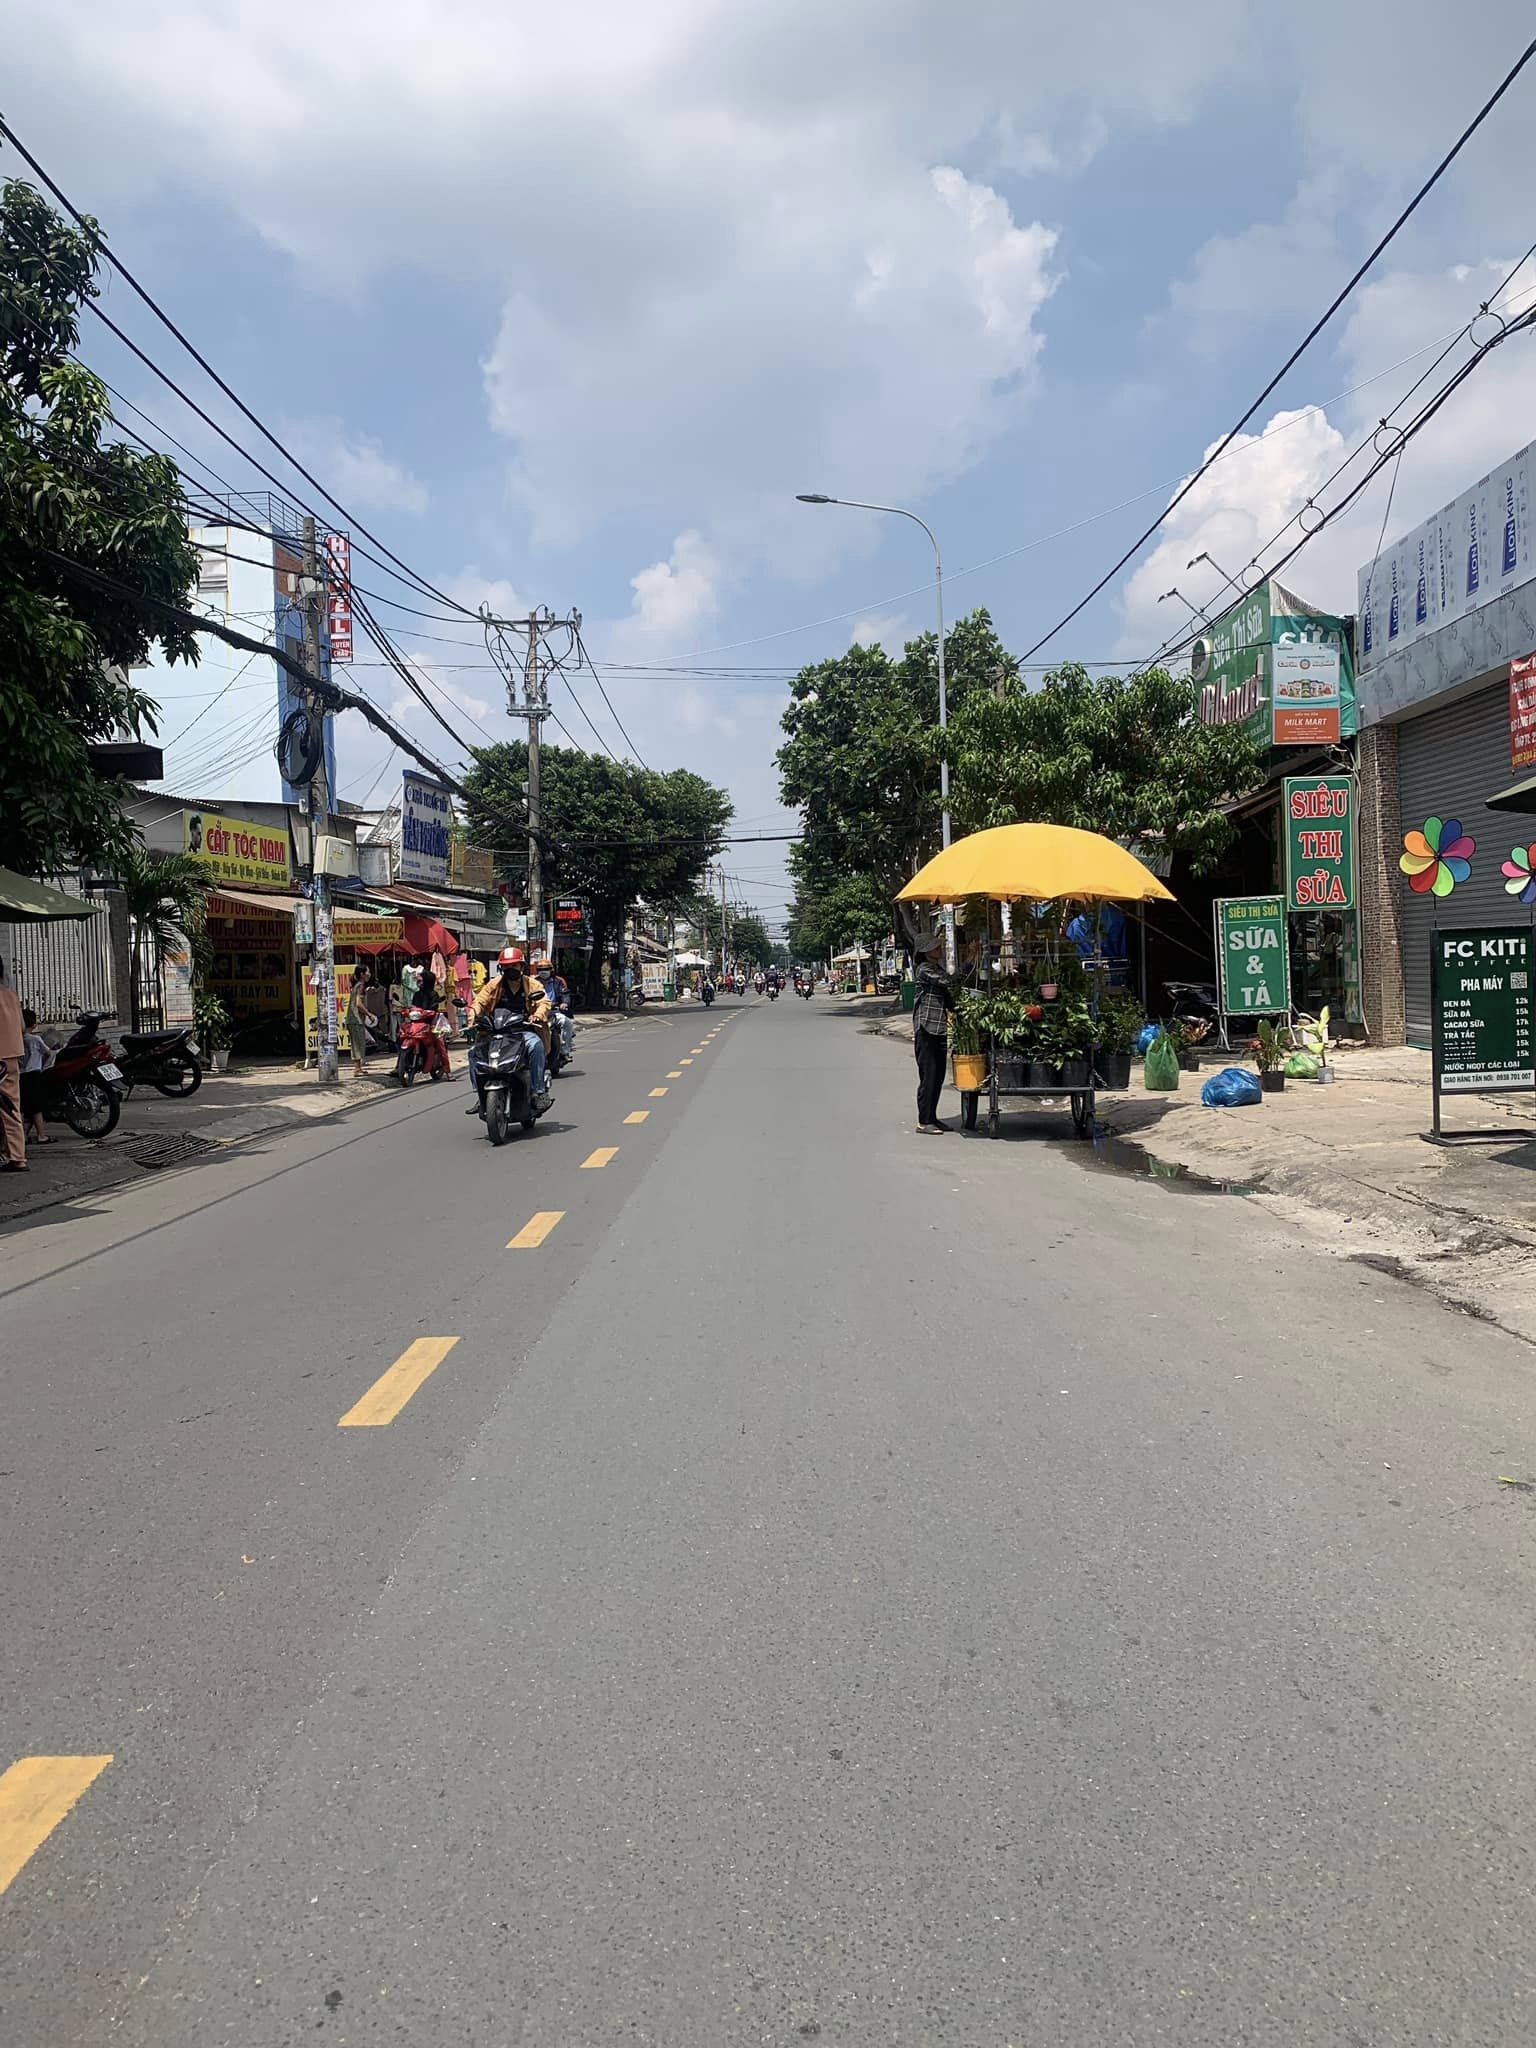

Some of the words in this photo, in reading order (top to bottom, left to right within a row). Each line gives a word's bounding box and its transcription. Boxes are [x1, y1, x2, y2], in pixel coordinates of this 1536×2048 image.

[1506, 477, 1514, 519] KING
[1469, 504, 1478, 543] KING
[1508, 520, 1517, 562] LION
[1471, 546, 1479, 590] LION
[1213, 633, 1230, 670] Siêu
[1232, 613, 1246, 655] Thị
[1247, 605, 1263, 641] Sữa
[1305, 718, 1328, 726] MART
[1290, 782, 1348, 819] SIÊU
[207, 819, 231, 856] CẮT
[233, 829, 257, 860] TÓC
[259, 838, 285, 865] NAM
[1298, 831, 1343, 864] THỊ
[1296, 869, 1346, 905] SỮA
[1248, 905, 1261, 918] THỊ
[1229, 926, 1279, 950] SỮA
[1443, 941, 1474, 958] FC
[1246, 954, 1264, 975] &
[1240, 979, 1273, 1007] TẢ
[1460, 978, 1481, 991] PHA
[1482, 974, 1503, 991] MÁY
[1443, 1021, 1468, 1029] CACAO
[1443, 1031, 1459, 1039] TRÀ
[1466, 1062, 1486, 1071] NGỌT
[1487, 1060, 1502, 1069] CÁC
